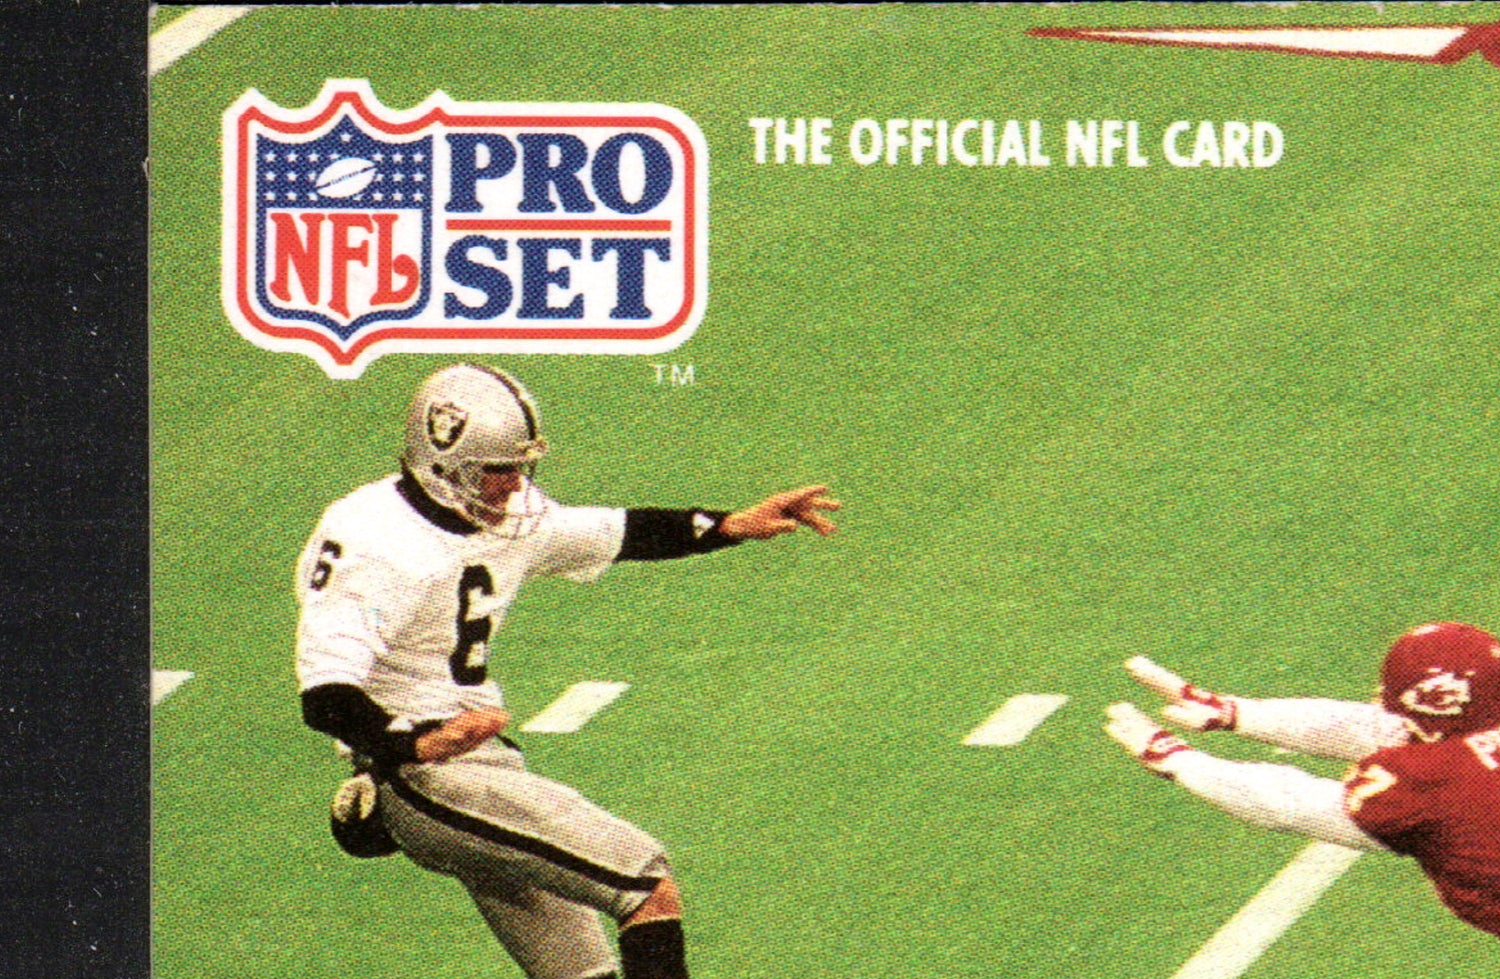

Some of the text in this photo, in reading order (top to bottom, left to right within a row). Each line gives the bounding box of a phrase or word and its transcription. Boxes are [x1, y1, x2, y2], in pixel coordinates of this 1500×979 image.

[444, 132, 674, 215] PRO
[749, 118, 1284, 168] THE OFFICIAL NFL CARD
[270, 212, 420, 319] NFL
[443, 235, 672, 321] SET
[653, 364, 696, 386] TM
[310, 540, 342, 591] 6
[449, 564, 494, 686] 6
